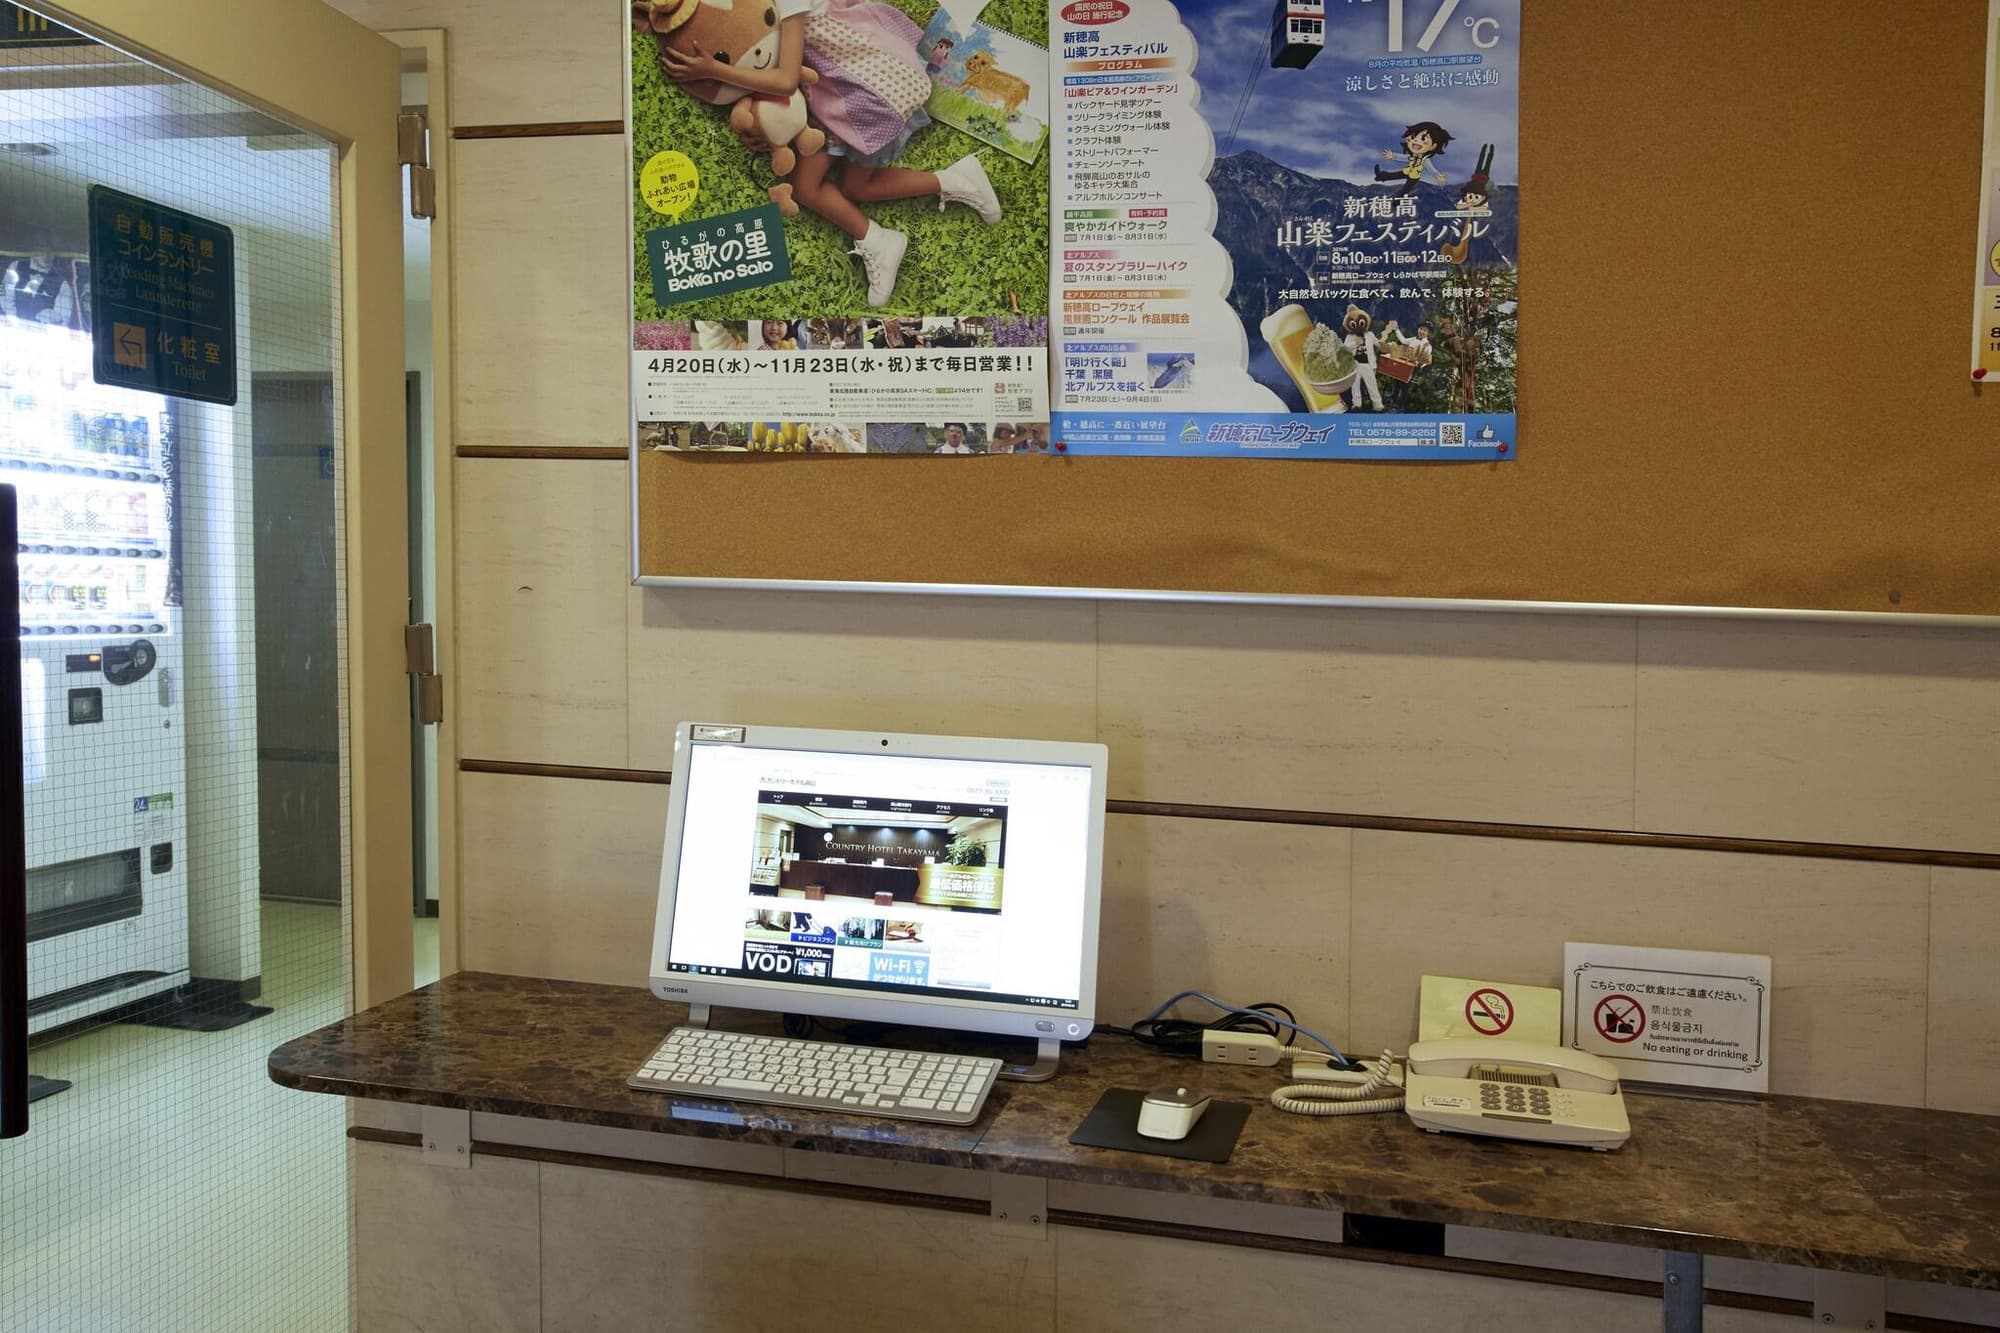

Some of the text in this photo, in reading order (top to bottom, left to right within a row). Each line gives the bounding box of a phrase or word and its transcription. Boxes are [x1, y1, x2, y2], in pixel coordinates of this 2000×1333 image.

[1067, 12, 1090, 21] 山の日
[1063, 30, 1100, 43] 新穂高
[1063, 42, 1168, 59] 山楽フェスティバル
[1098, 60, 1143, 70] プログラム
[1345, 69, 1499, 92] 涼しさと絶景に感動
[1074, 99, 1161, 109] バックヤード見学ツアー
[1074, 110, 1161, 121] ツリークライミング体験
[1074, 121, 1170, 133] クライミングウォール体験
[1074, 136, 1121, 145] クラフト体験
[1074, 147, 1159, 157] ストリートパフォーマー
[1074, 160, 1144, 168] チェーンソーアート
[660, 173, 677, 184] 動物
[1074, 180, 1138, 189] ゆるキャラ大集合
[647, 180, 696, 199] ふれあい広場
[656, 192, 692, 208] オープン!
[1344, 194, 1418, 218] 新穂高
[1064, 220, 1168, 232] 爽やかガイドウォーク
[1277, 217, 1490, 247] 山楽フェスティバル
[116, 213, 214, 258] 自動販売機
[118, 240, 215, 275] コインランドリー
[664, 230, 771, 277] 牧歌の里
[1064, 262, 1188, 272] 夏のスタンプラリーハイク
[714, 269, 735, 283] no
[1278, 287, 1490, 300] 大自然をバックに食べて、飲んで、体験する。
[1064, 302, 1145, 312] 新穂高ロープウェイ
[157, 331, 220, 364] 化粧室
[174, 361, 207, 382] Toilet
[1065, 369, 1085, 379] 千葉
[1065, 382, 1145, 391] 北アルプスを描く
[1207, 420, 1336, 443] 新穂高ロープウェイ
[1349, 428, 1436, 437] TEL 0578-89-2252
[825, 841, 941, 857] COUNTRY HOTEL TAKAYAMA
[802, 935, 835, 944] ビジネスプラン
[795, 947, 822, 958] ¥1,000
[745, 952, 792, 974] VOD
[874, 957, 911, 972] Wi-Fi
[1590, 980, 1747, 1002] こちらでのご飲食はご遠慮ください。
[1651, 1004, 1693, 1017] 禁止饮食
[1650, 1019, 1702, 1034] 음식물금지
[1642, 1042, 1748, 1061] No eating or drinking
